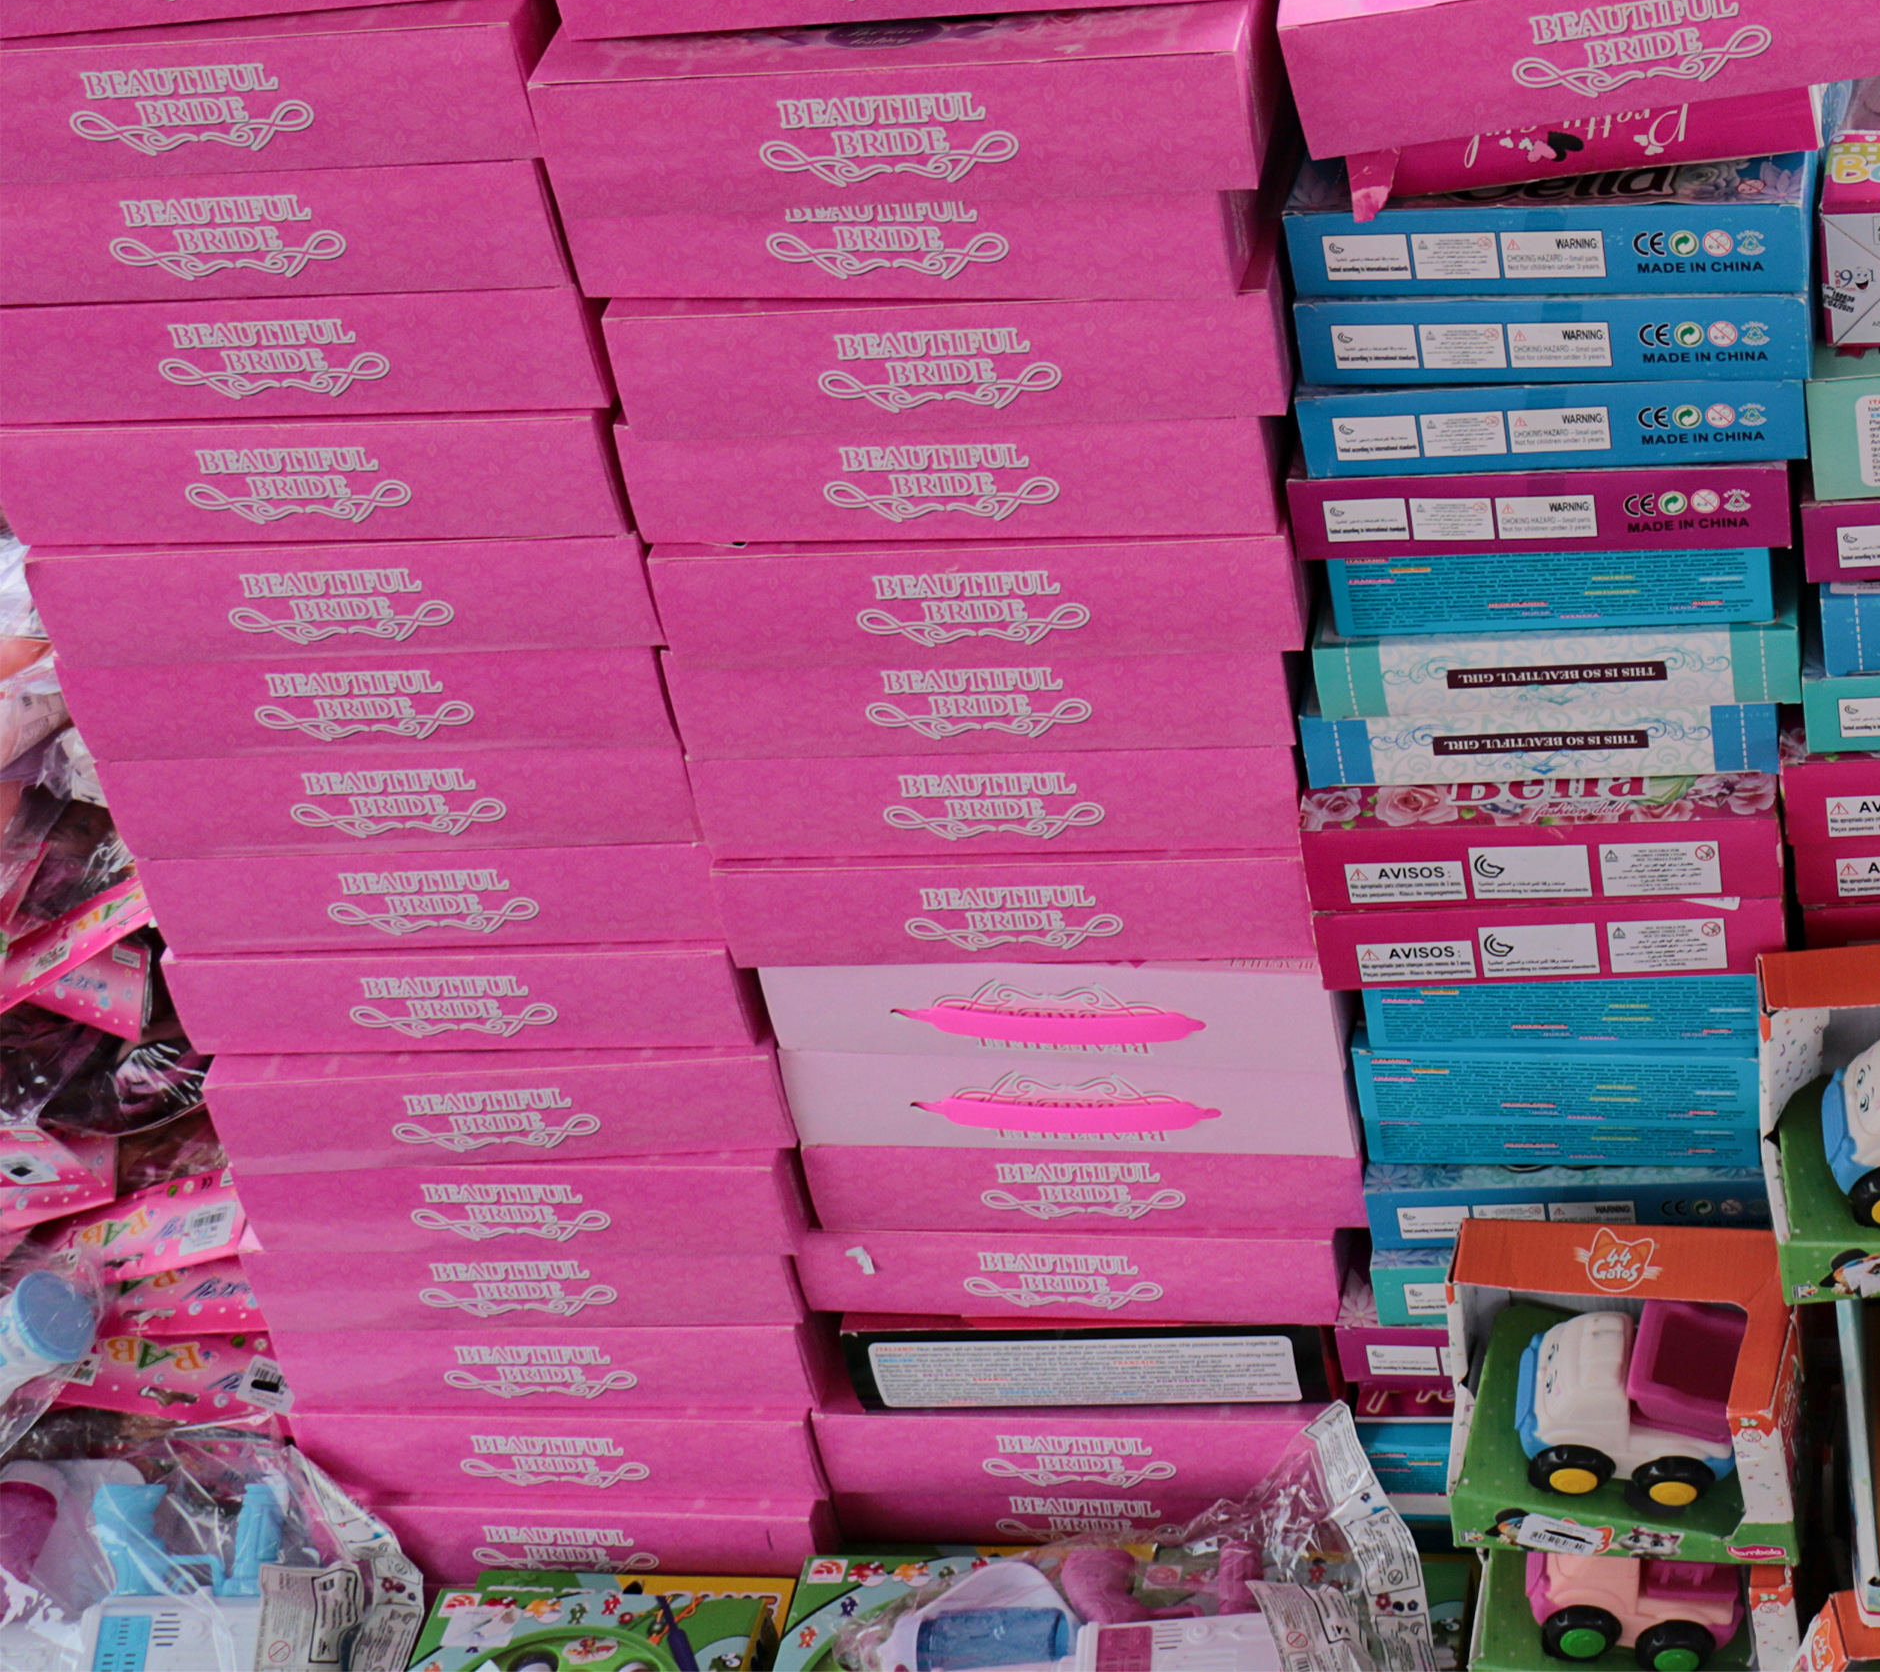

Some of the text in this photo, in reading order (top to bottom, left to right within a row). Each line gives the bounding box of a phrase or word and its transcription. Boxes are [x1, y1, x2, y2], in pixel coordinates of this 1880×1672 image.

[1584, 27, 1703, 70] BRIDE
[79, 62, 280, 101] BEAUTIFUL
[134, 97, 250, 129] BRIDE
[776, 92, 986, 129] BEAUTIFUL
[831, 126, 951, 157] BRIDE
[1555, 237, 1600, 250] WARNING:
[1637, 260, 1765, 274] MADE IN CHINA
[834, 328, 1031, 360] BEAUTIFUL
[885, 358, 998, 388] BRIDE
[194, 445, 379, 476] BEAUTIFUL
[245, 474, 351, 501] BRIDE
[1458, 666, 1656, 685] THIS IS SO BEAUTIFUL GIRL
